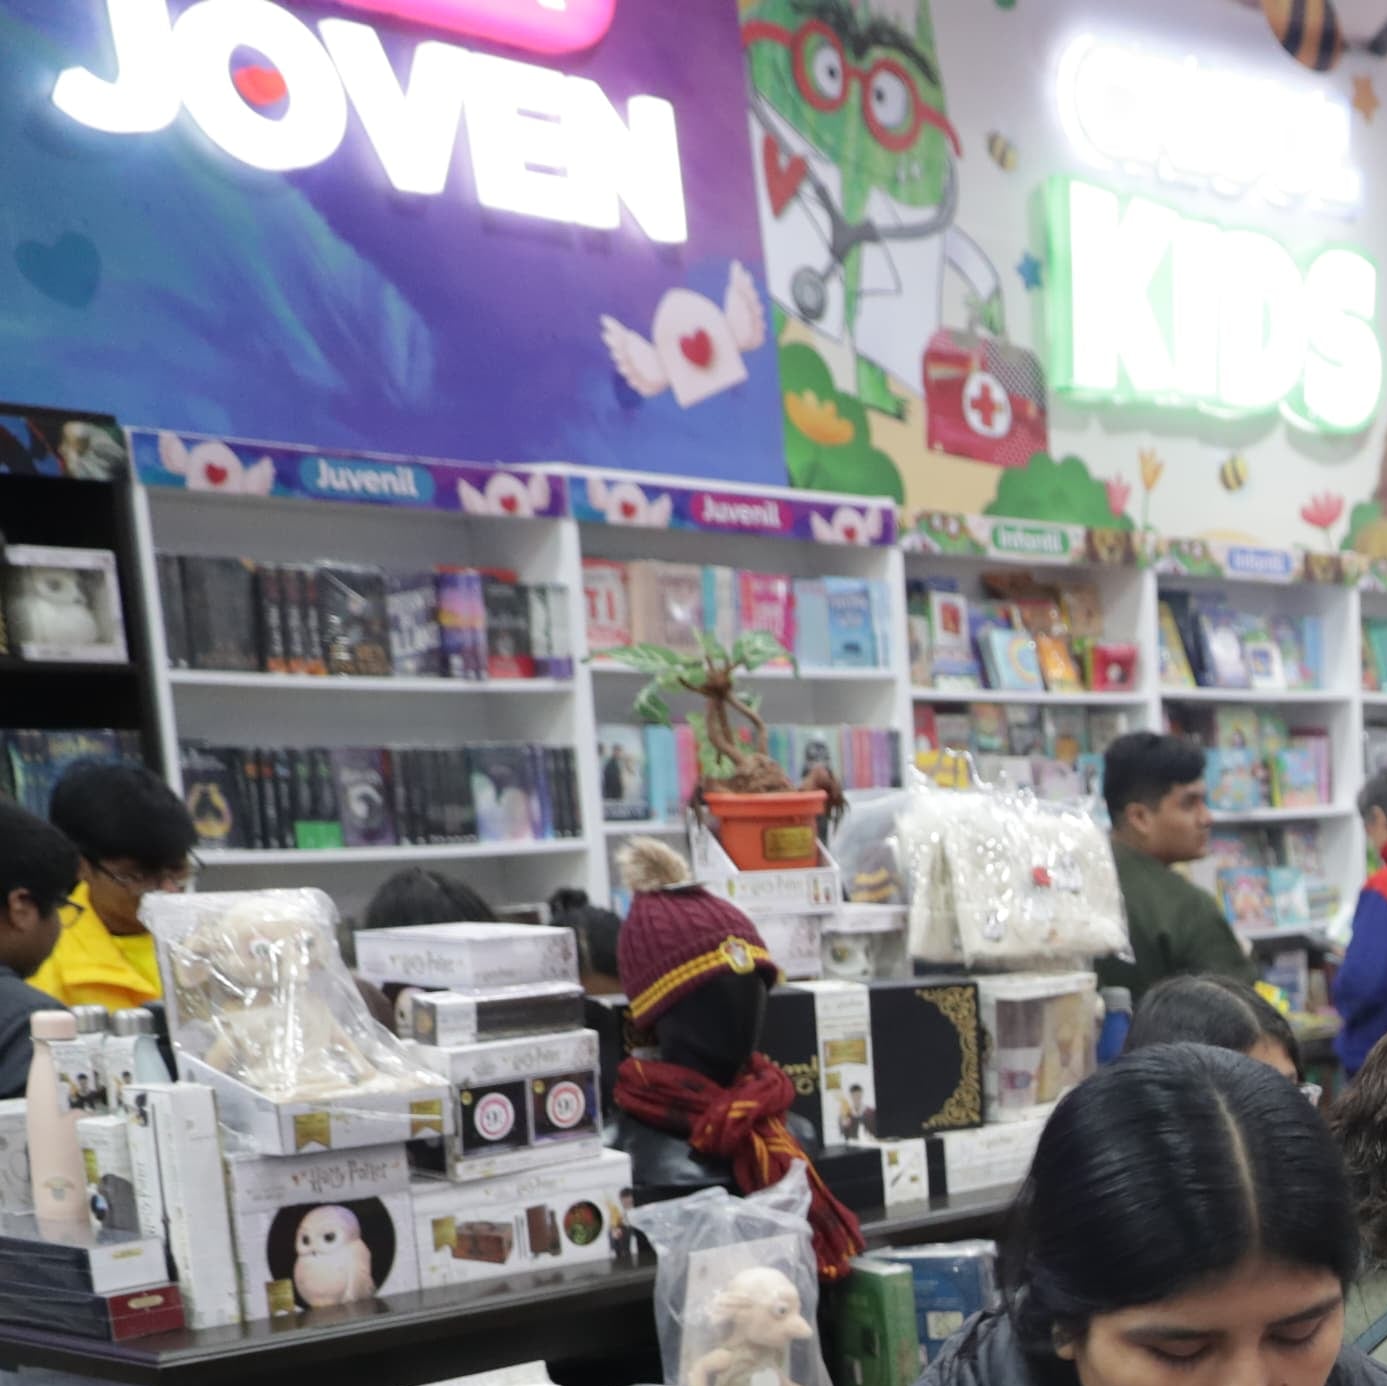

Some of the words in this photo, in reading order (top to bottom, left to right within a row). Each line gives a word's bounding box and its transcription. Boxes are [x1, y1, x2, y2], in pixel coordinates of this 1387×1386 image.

[53, 0, 688, 244] JOVEN
[1066, 176, 1380, 430] KIDS
[314, 457, 420, 498] Juvenil
[702, 494, 782, 530] Juvenil
